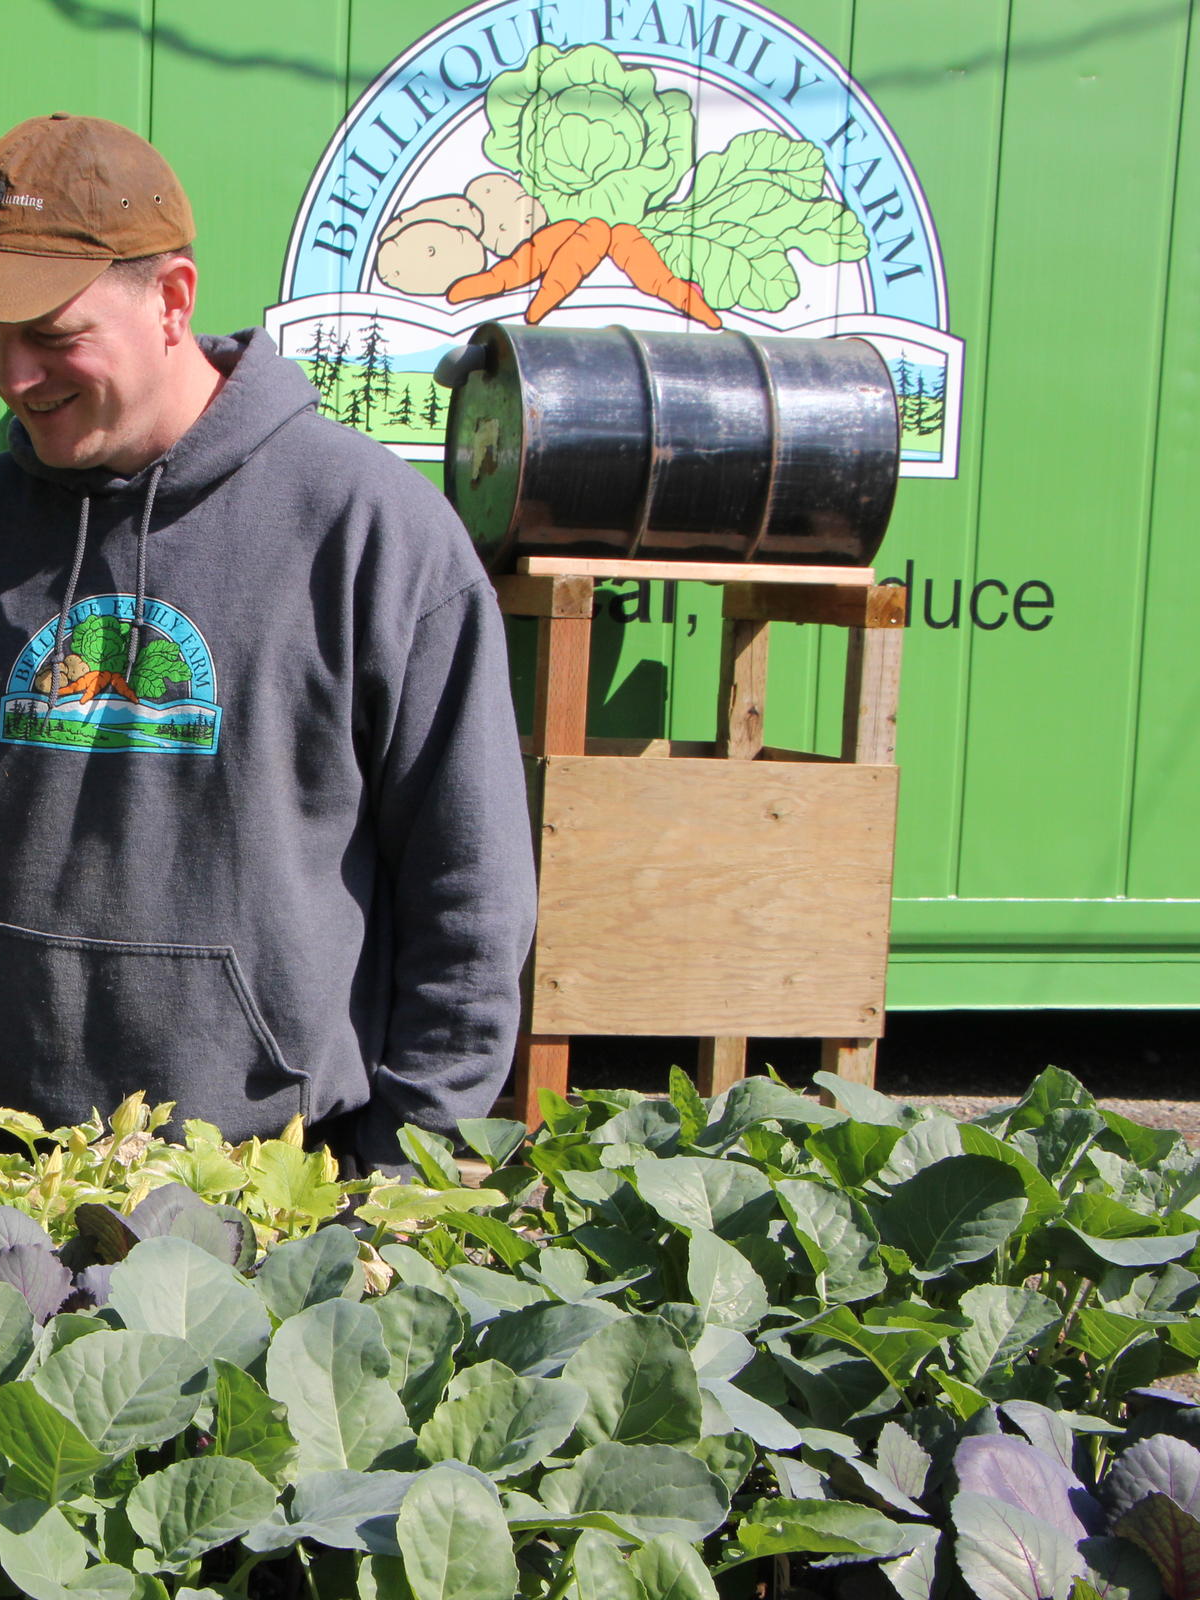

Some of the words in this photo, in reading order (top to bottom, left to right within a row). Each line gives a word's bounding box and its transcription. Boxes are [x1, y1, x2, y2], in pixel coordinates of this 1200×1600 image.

[311, 3, 569, 264] BELLEQUE
[601, 0, 824, 108] FAMILY
[822, 110, 925, 288] FARM
[877, 559, 1055, 631] duce
[180, 633, 210, 688] FARM
